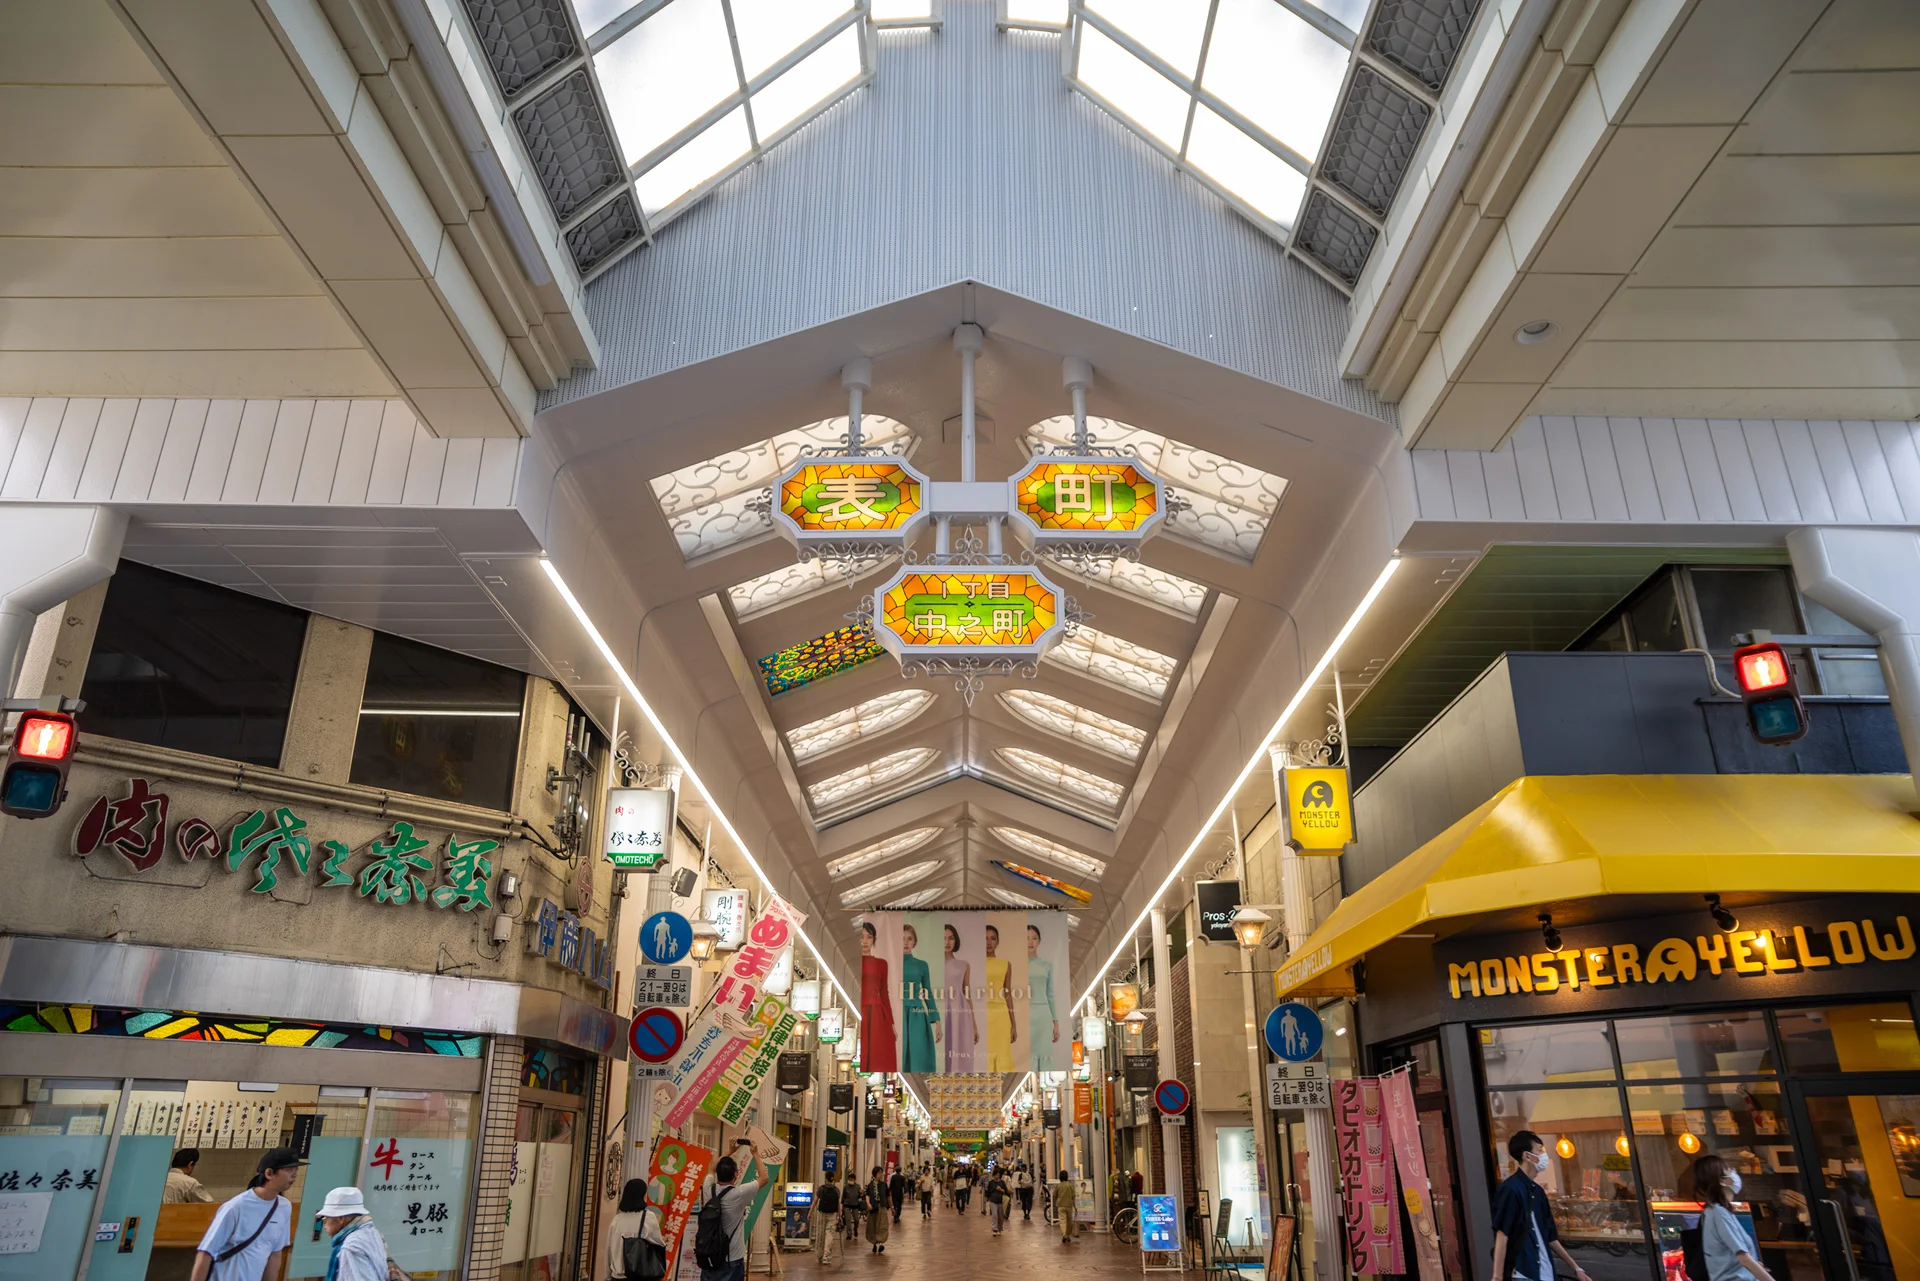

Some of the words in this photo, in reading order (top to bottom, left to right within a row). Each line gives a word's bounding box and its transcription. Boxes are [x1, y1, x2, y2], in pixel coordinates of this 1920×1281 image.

[816, 473, 887, 523] 表
[1054, 473, 1119, 522] 町
[914, 608, 1025, 638] 中之町
[615, 805, 635, 816] 肉の
[1300, 811, 1341, 819] MONSTER
[1302, 820, 1339, 828] YELLOW
[538, 898, 612, 991] 伊藤ハム
[715, 913, 790, 1011] めまい
[1448, 943, 1644, 999] MONSTER
[1696, 915, 1918, 975] YELLOW
[646, 968, 681, 979] 終日
[638, 993, 688, 1004] 自転車を除く
[900, 981, 957, 1000] Haut
[965, 981, 1033, 1000] tricot
[638, 1068, 671, 1077] 2輪を除く
[722, 1012, 799, 1126] 自律神経の調整
[1277, 1066, 1315, 1077] 終日
[1273, 1093, 1326, 1105] 自転車を除く
[271, 1106, 282, 1134] ハムカツ
[370, 1137, 404, 1181] 牛
[409, 1162, 425, 1170] タン
[0, 1168, 99, 1191] 佐々奈美
[408, 1173, 432, 1181] テール
[1340, 1080, 1368, 1274] タピオカドリンク
[402, 1202, 448, 1225] 黒豚
[664, 1160, 703, 1273] 坐骨神経痛
[410, 1227, 444, 1236] 肩ロース
